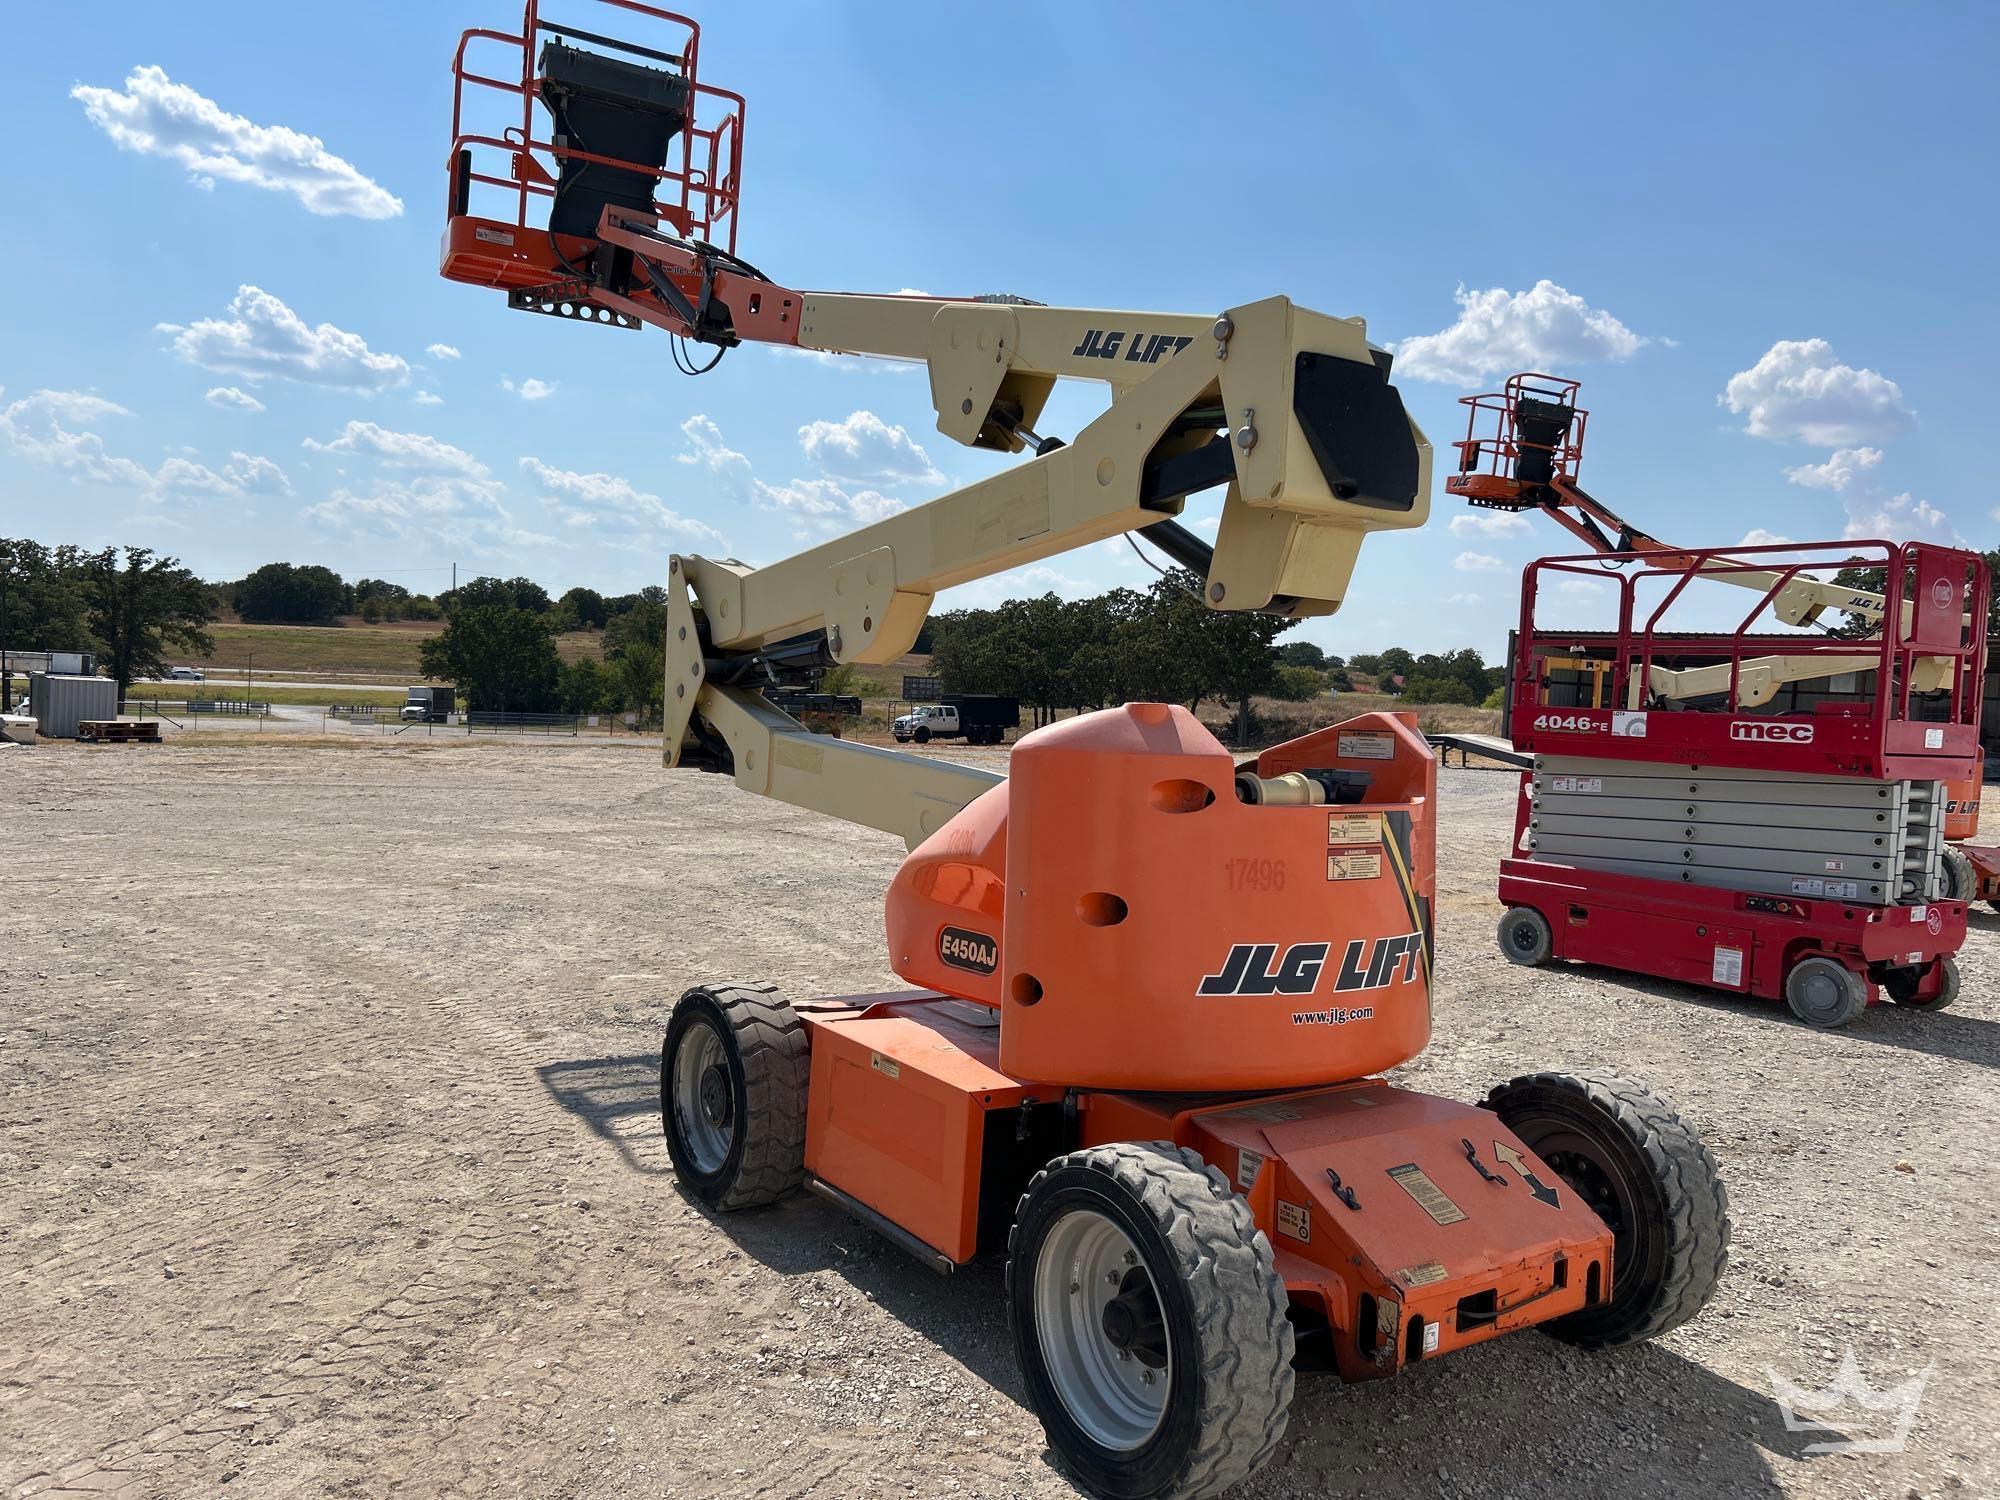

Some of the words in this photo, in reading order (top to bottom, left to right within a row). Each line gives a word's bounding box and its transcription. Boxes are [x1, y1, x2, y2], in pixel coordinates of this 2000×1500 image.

[1072, 329, 1126, 359] JLG
[1124, 333, 1194, 364] LIFT
[1452, 476, 1471, 487] JLG
[1848, 597, 1873, 608] JLG
[1732, 723, 1812, 741] mec
[1225, 858, 1286, 892] 17496
[941, 934, 997, 967] E450AJ
[1195, 942, 1331, 996] JLG
[1333, 931, 1424, 993] LIFT
[1292, 1005, 1374, 1026] www.jlg.com
